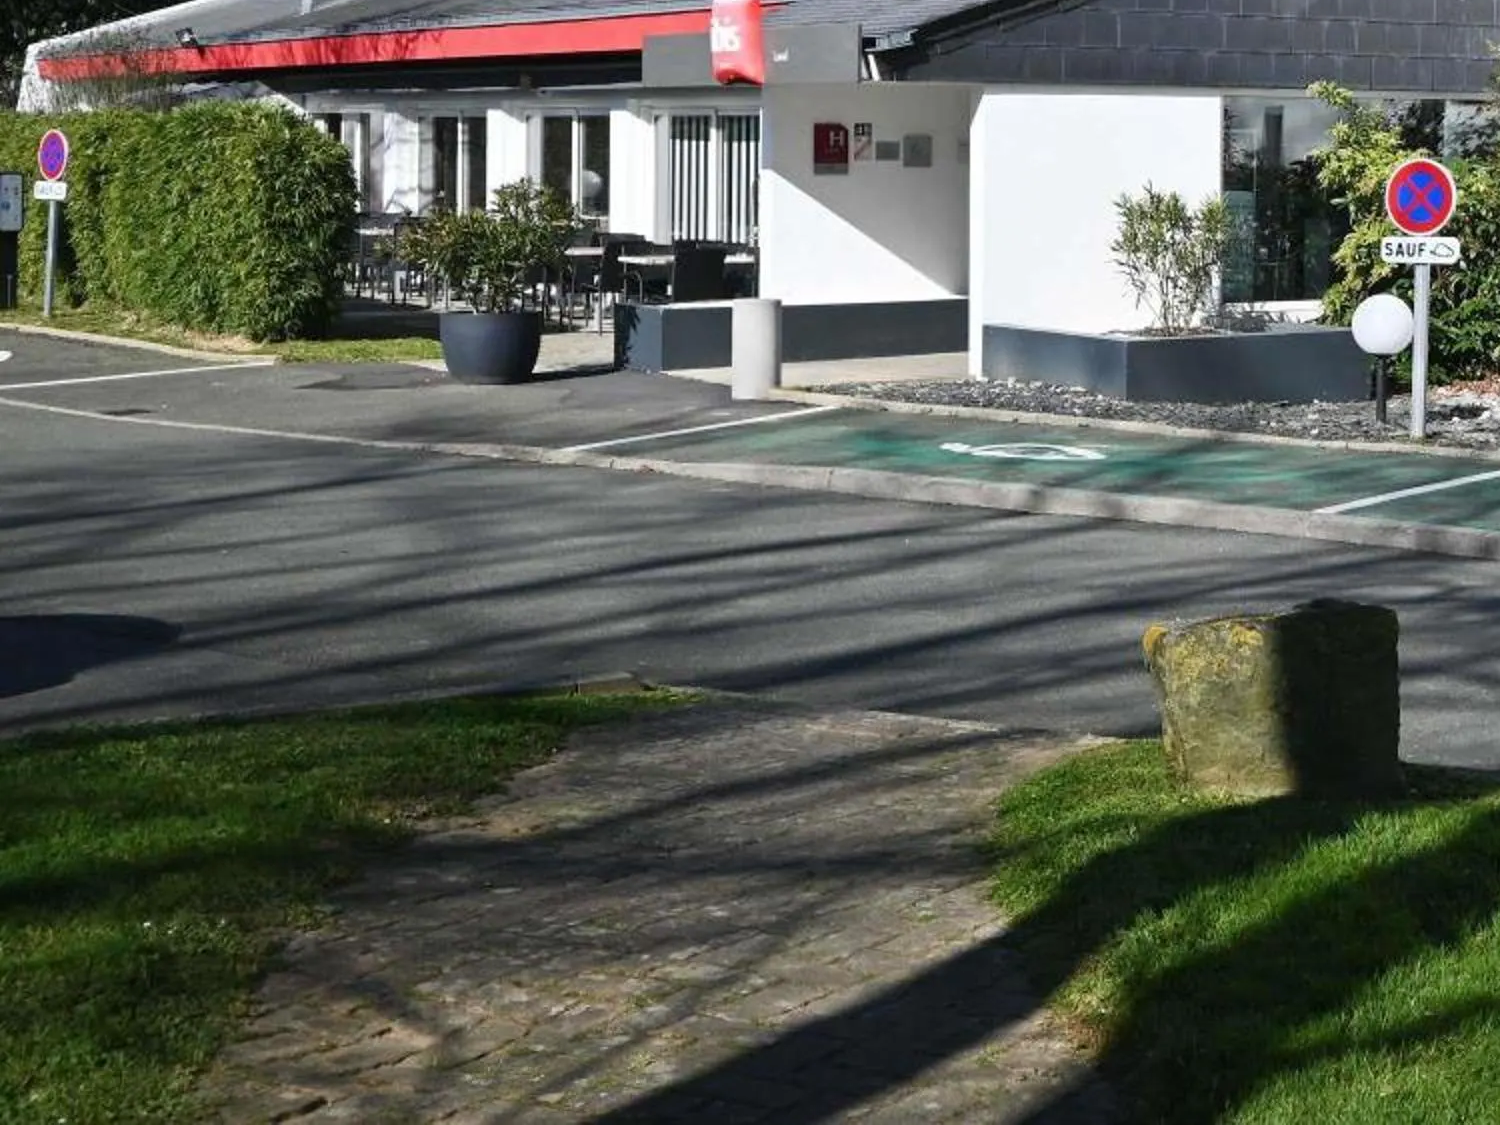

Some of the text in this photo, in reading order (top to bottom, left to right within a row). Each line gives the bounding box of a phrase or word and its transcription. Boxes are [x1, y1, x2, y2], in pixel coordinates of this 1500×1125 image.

[710, 17, 741, 52] bis
[829, 130, 844, 147] H
[1385, 242, 1427, 258] SAUF
